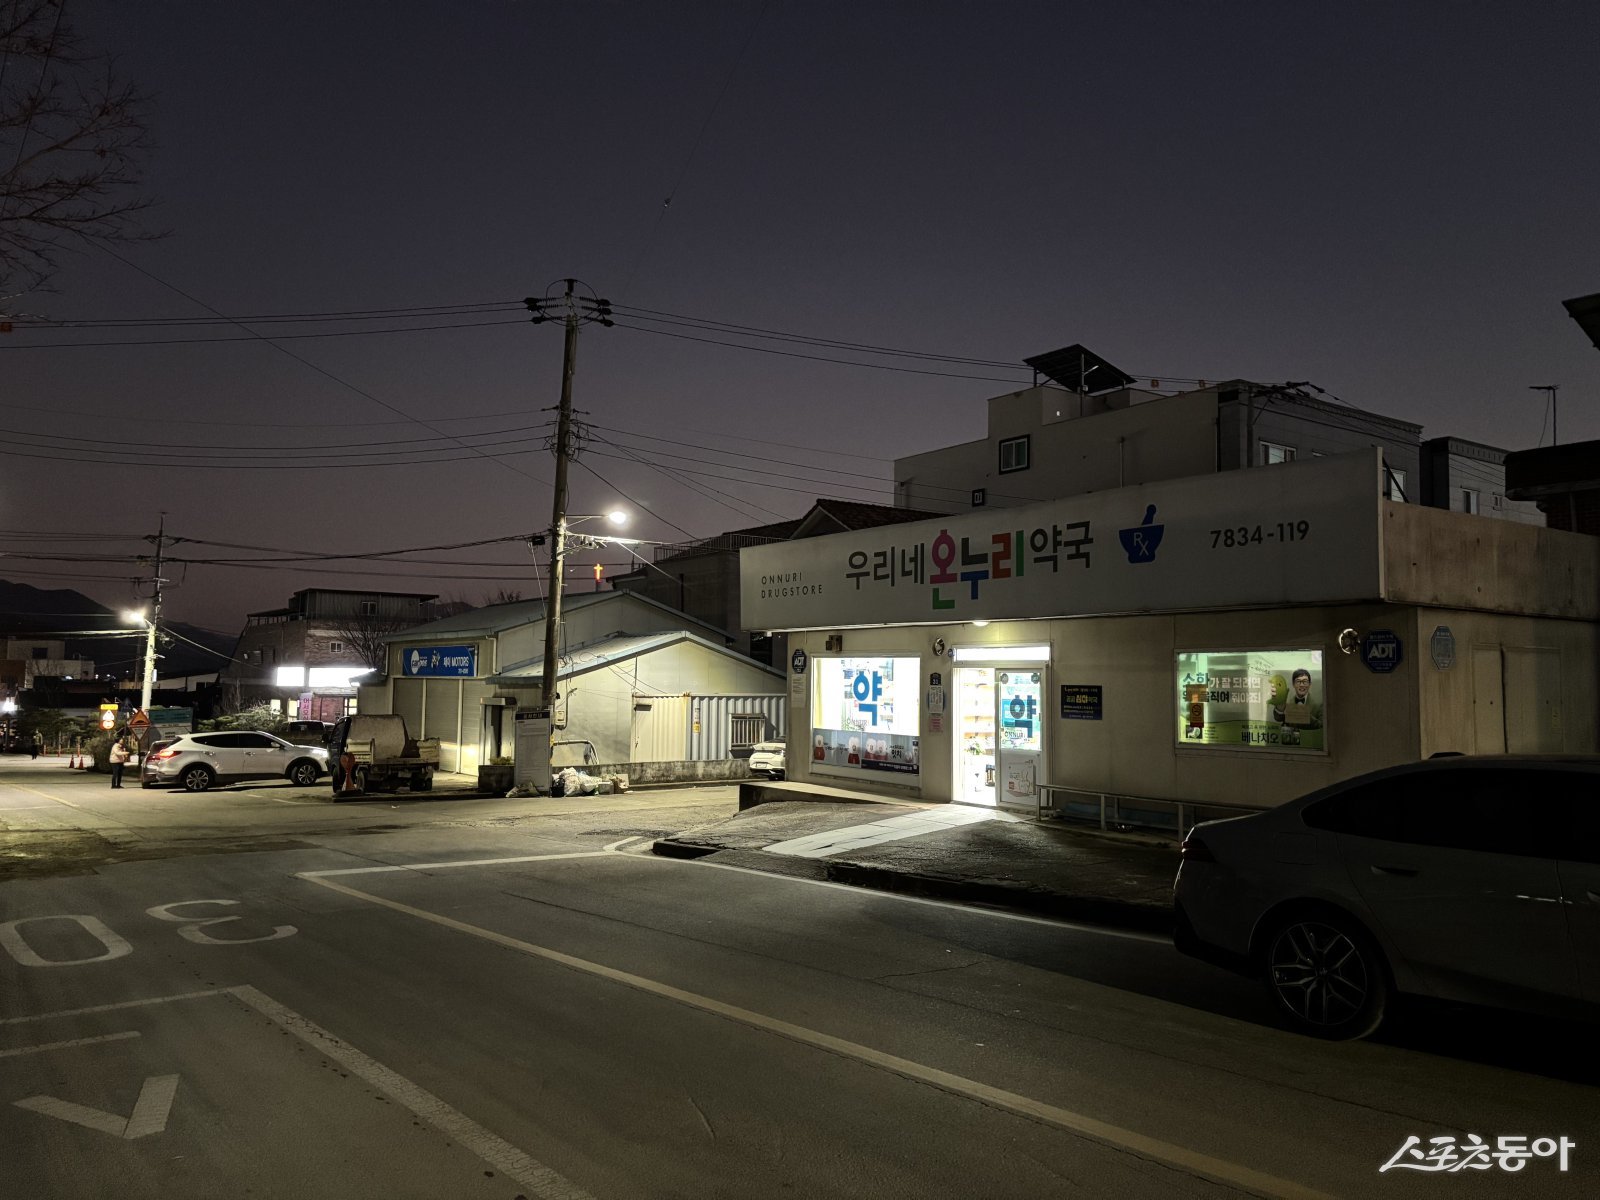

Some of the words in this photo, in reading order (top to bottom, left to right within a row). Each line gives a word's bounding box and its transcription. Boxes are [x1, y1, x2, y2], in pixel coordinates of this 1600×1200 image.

[1210, 520, 1310, 549] 7834-119
[761, 572, 802, 585] ONNURI
[761, 584, 823, 599] DRUGSTORE
[1368, 643, 1396, 659] ADT
[853, 671, 883, 726] 약
[1010, 695, 1037, 738] 약
[1241, 731, 1280, 744] 베나치오
